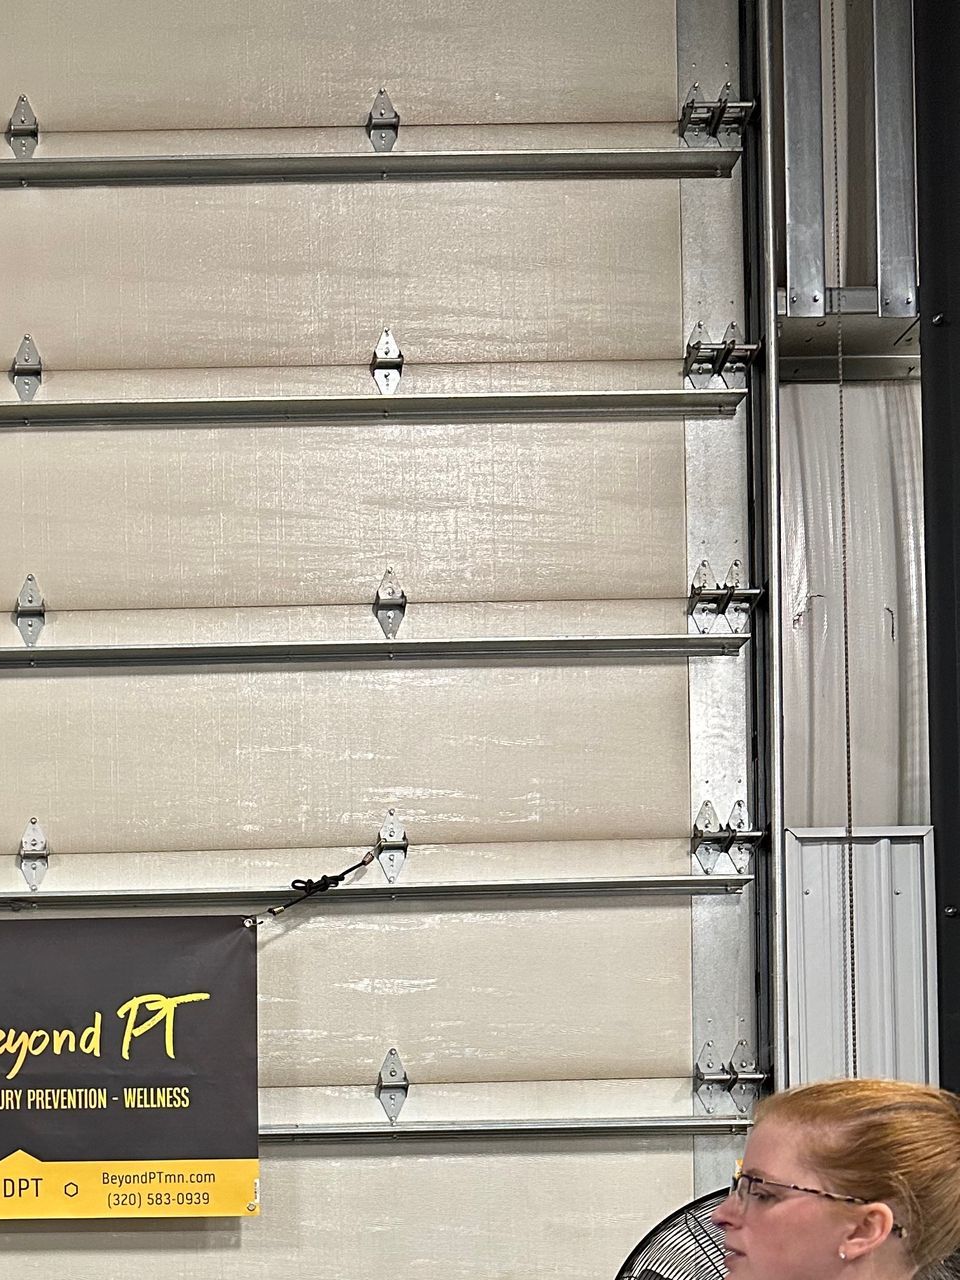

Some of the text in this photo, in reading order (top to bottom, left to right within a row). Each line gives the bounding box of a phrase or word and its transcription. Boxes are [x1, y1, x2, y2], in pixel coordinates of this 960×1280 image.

[116, 992, 211, 1061] PT
[27, 1088, 107, 1110] PREVENTION
[123, 1086, 190, 1108] WELLNESS
[3, 1177, 44, 1198] DPT
[102, 1171, 216, 1188] BeyondPTmn.com
[107, 1191, 210, 1209] (320) 583-0939
